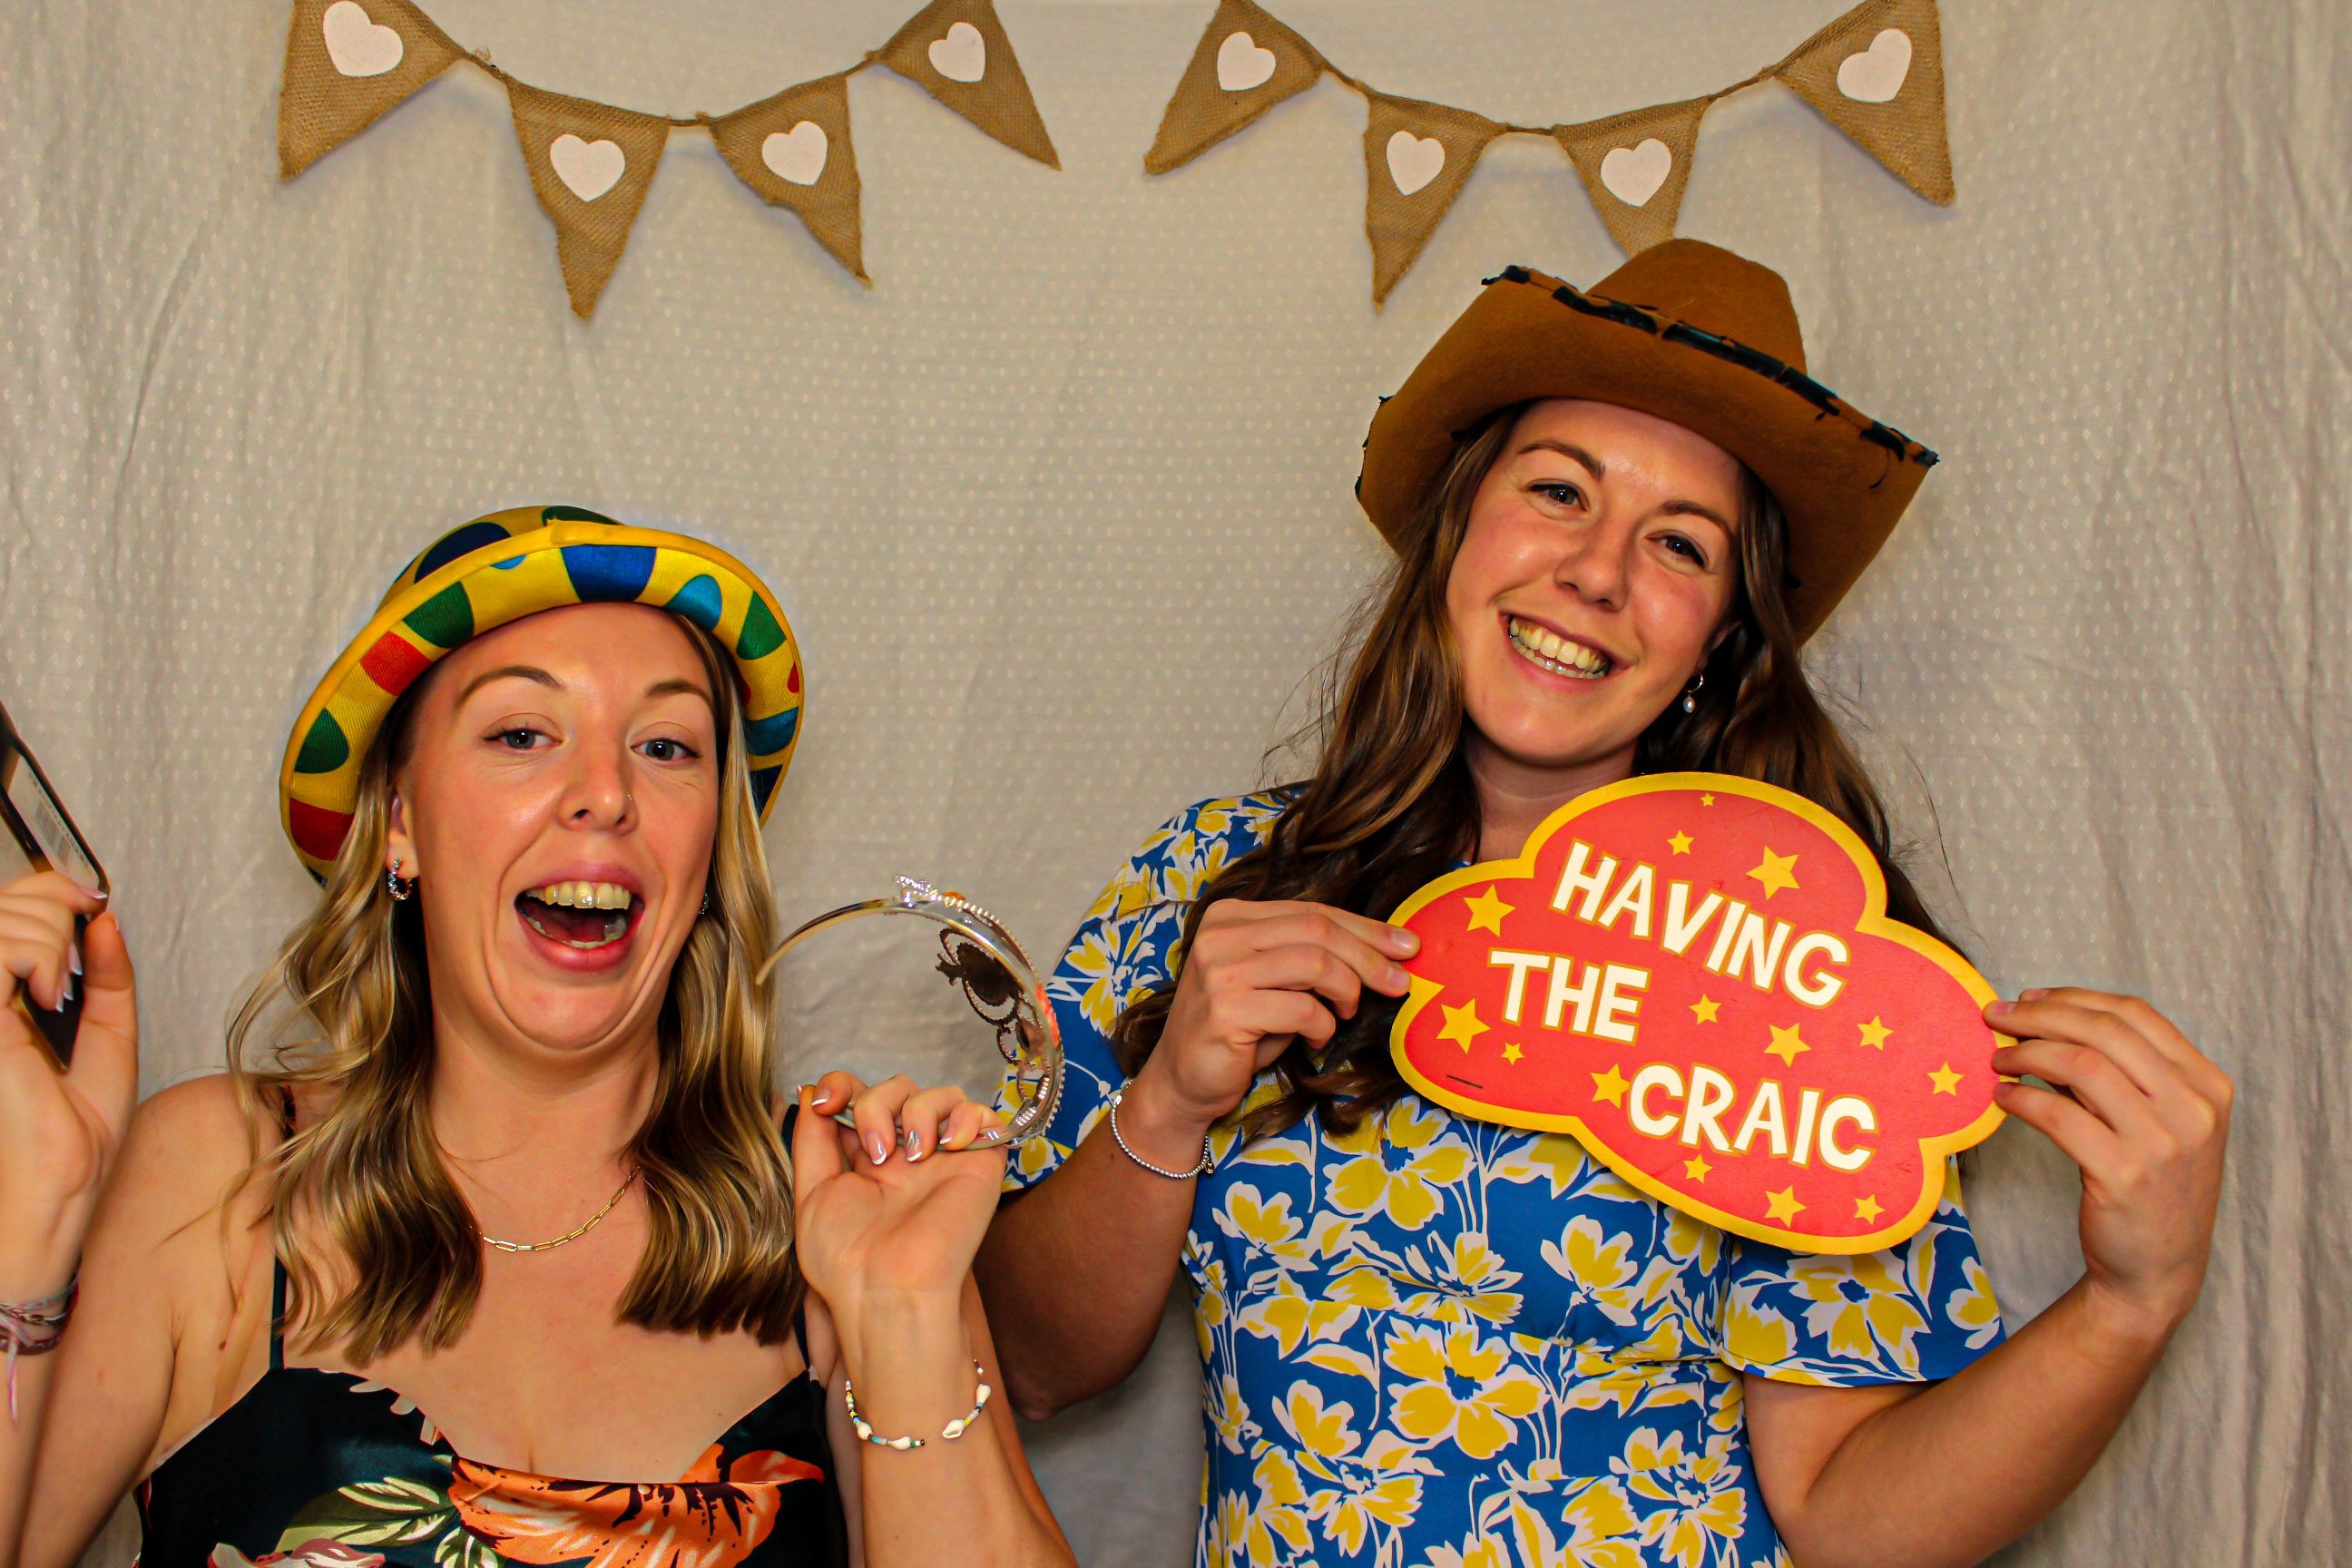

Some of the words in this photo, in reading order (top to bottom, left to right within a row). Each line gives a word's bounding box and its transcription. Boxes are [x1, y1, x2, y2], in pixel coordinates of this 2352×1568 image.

[1551, 839, 1849, 1008] HAVING
[1489, 949, 1650, 1044] THE
[1629, 1063, 1877, 1171] CRAIC
